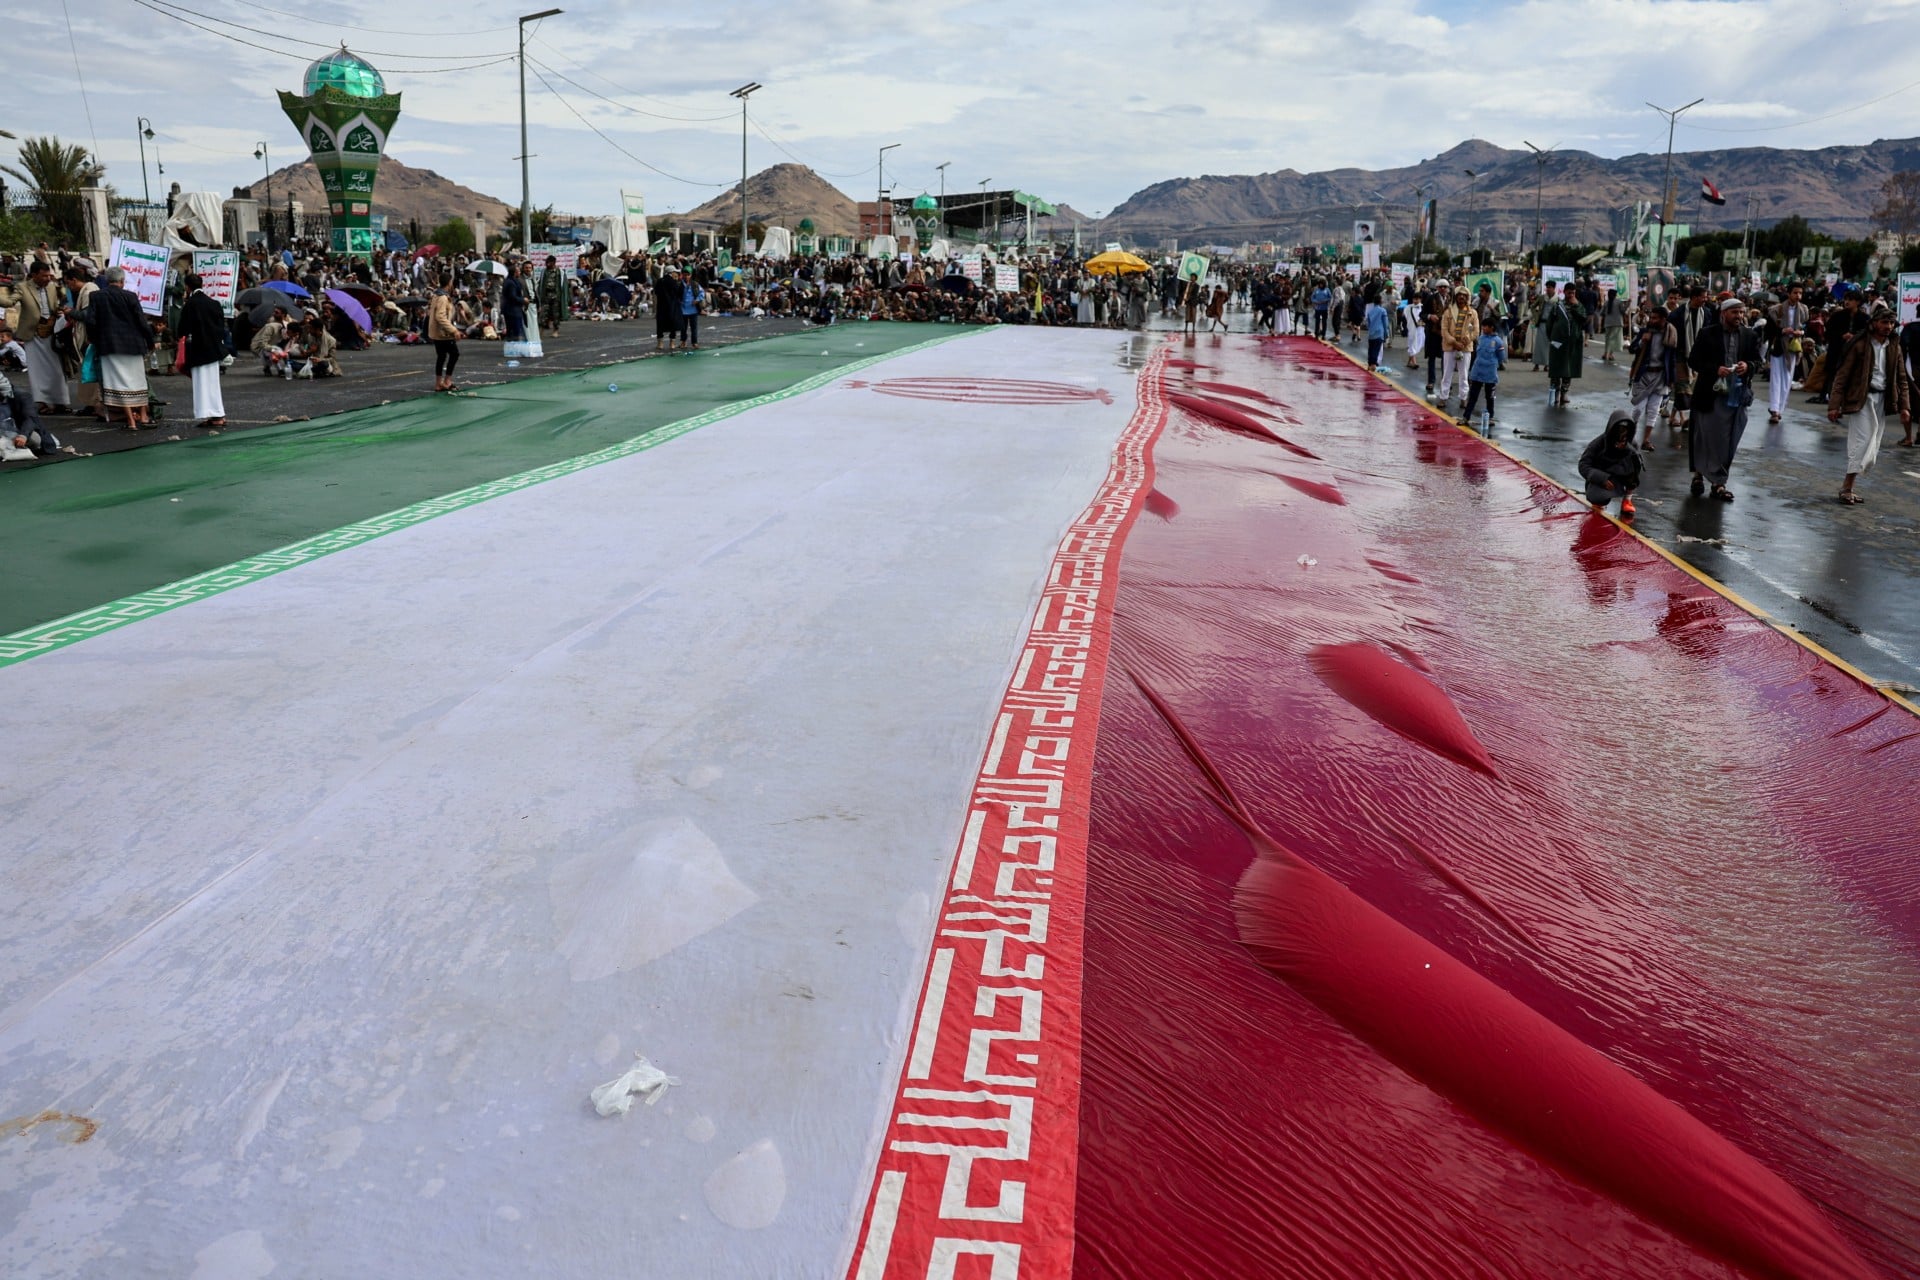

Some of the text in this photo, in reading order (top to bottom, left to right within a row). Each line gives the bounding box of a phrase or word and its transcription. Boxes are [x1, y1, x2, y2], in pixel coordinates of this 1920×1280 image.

[350, 132, 375, 151] محمد
[122, 245, 166, 263] قاطعوا
[198, 254, 235, 269] الله أكبر
